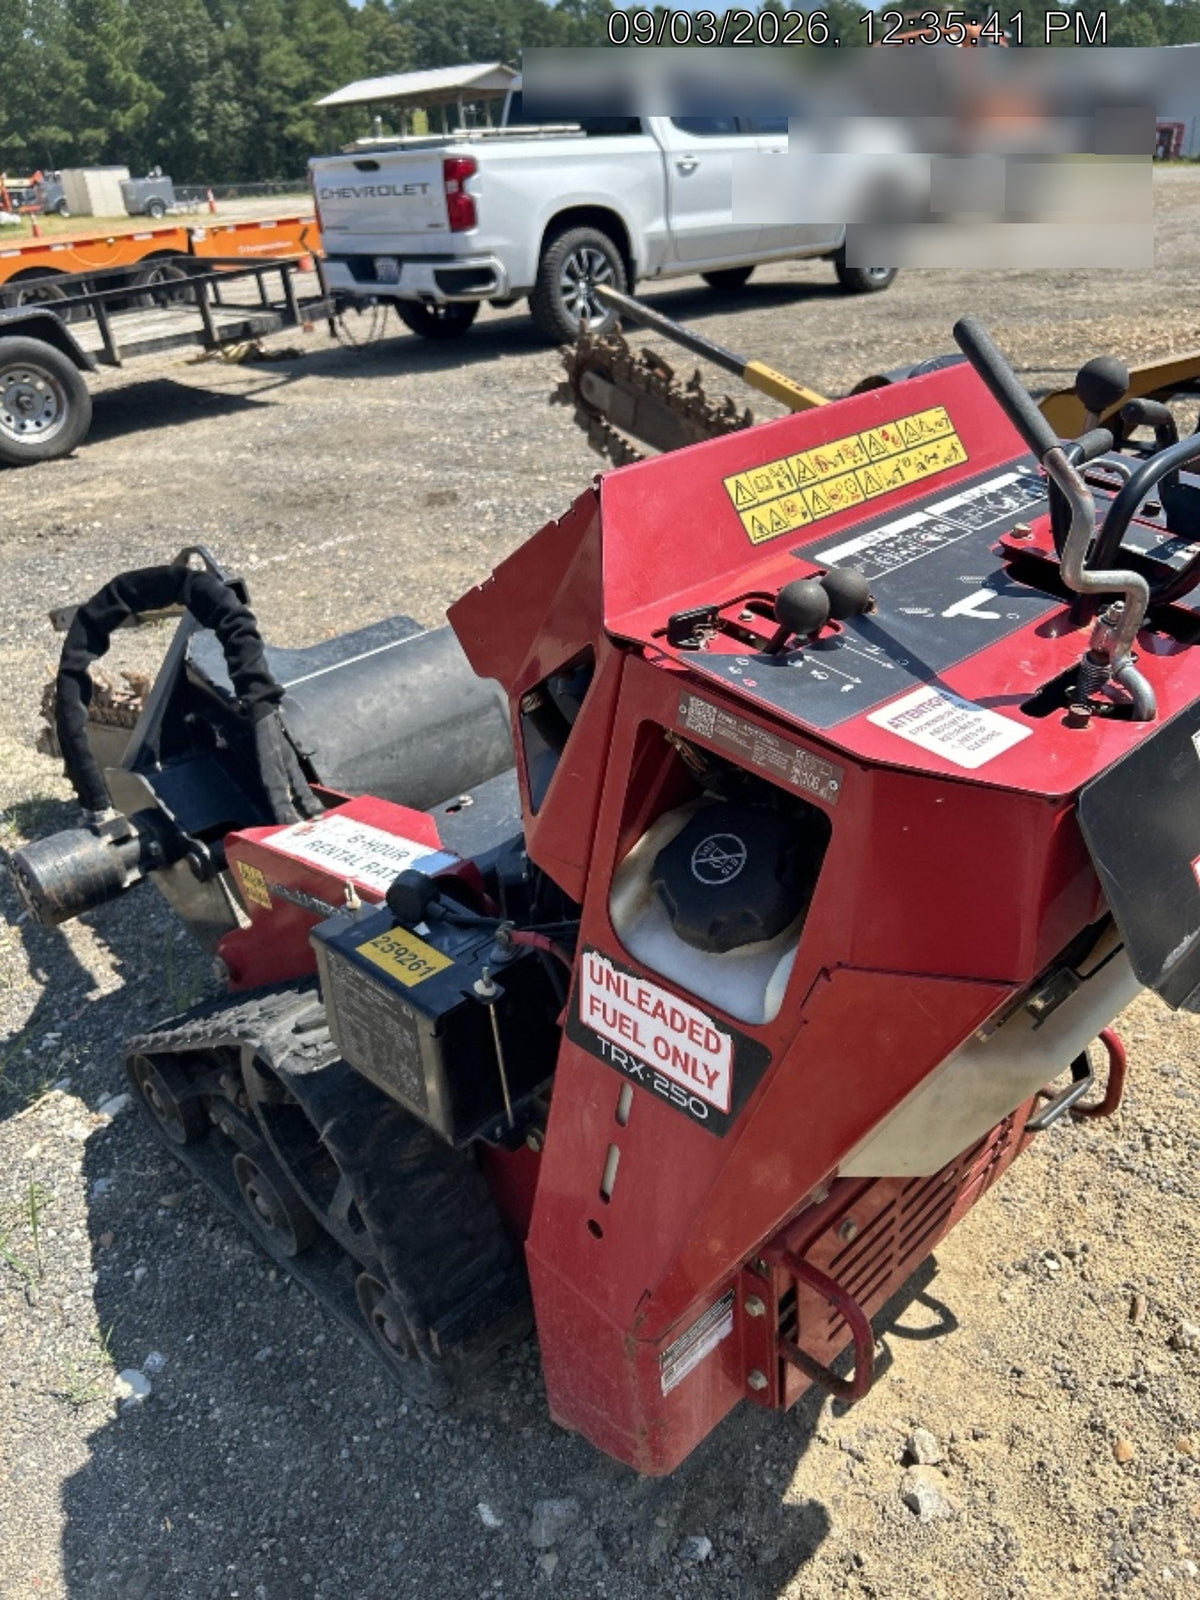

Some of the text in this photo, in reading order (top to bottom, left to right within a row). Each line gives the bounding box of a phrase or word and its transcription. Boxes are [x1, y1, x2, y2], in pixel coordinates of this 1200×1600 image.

[320, 182, 431, 200] CHEVROLET
[304, 840, 401, 882] RENTAL RAT
[370, 936, 437, 978] 259261
[589, 958, 723, 1055] UNLEADED
[589, 994, 721, 1090] FUEL ONLY
